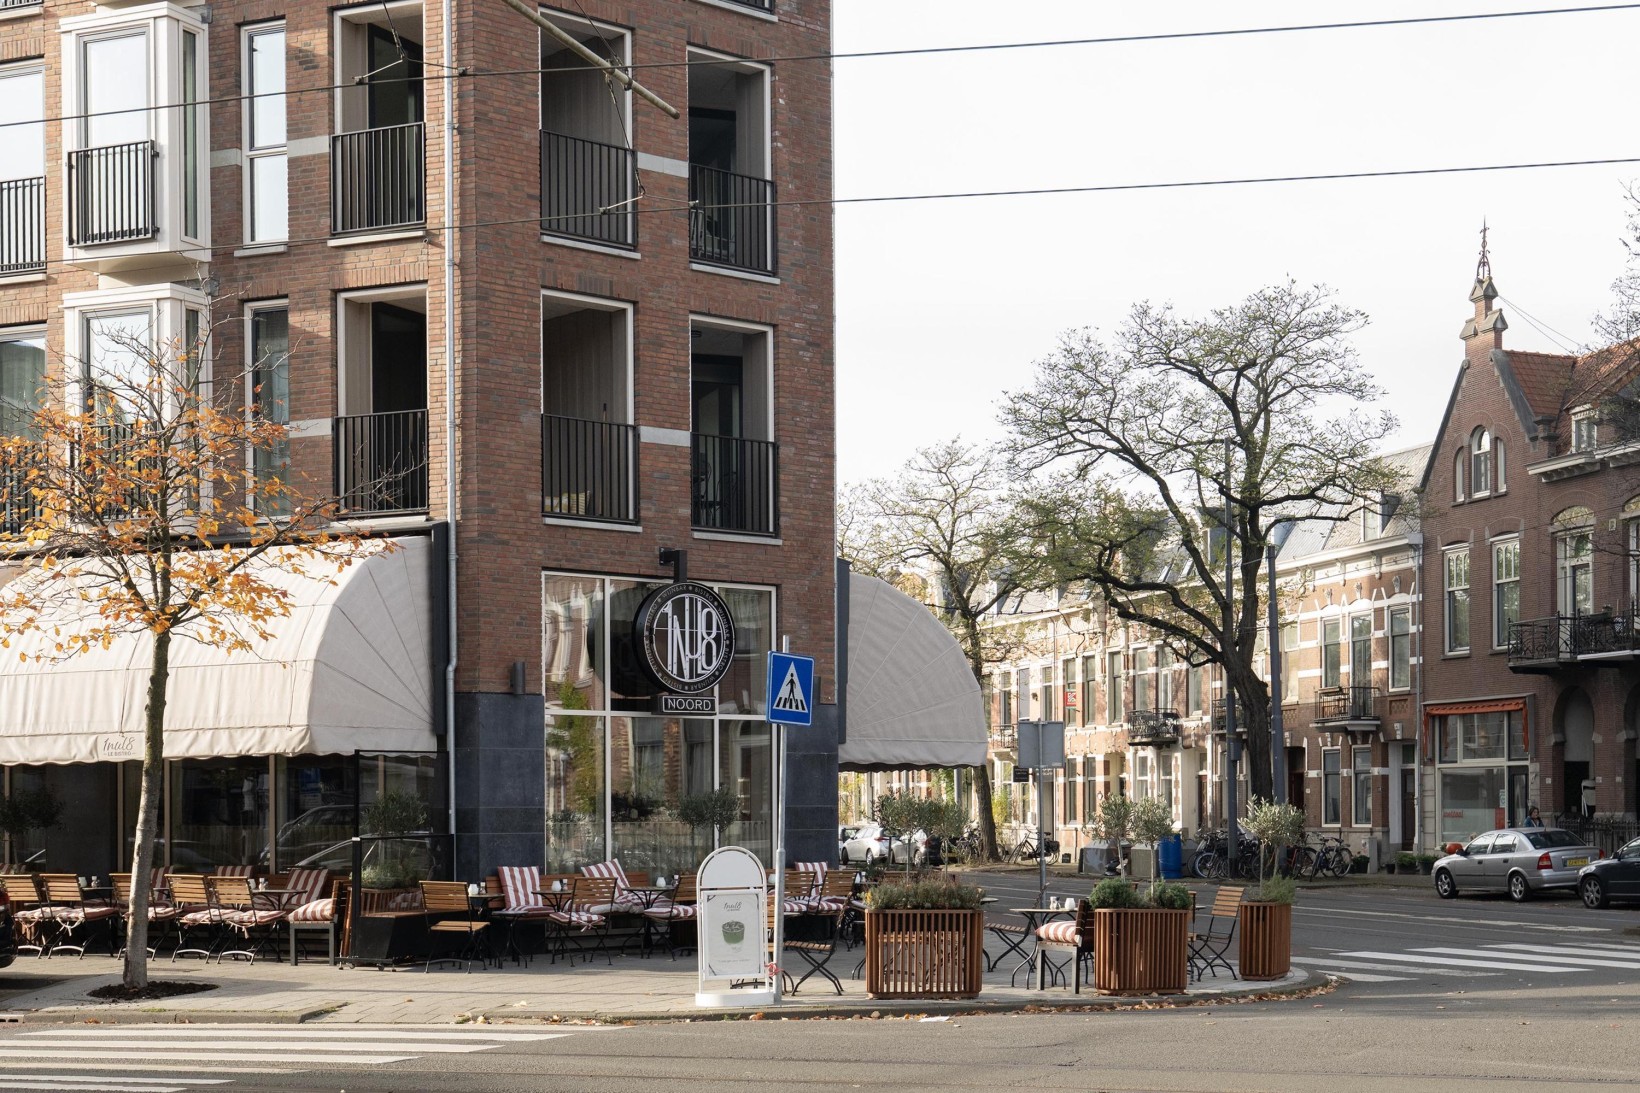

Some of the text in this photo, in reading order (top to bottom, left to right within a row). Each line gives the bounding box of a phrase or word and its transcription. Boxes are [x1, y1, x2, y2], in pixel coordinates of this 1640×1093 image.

[662, 584, 687, 598] WIJNBAR
[694, 587, 714, 602] BISTRO
[667, 698, 711, 711] NOORD
